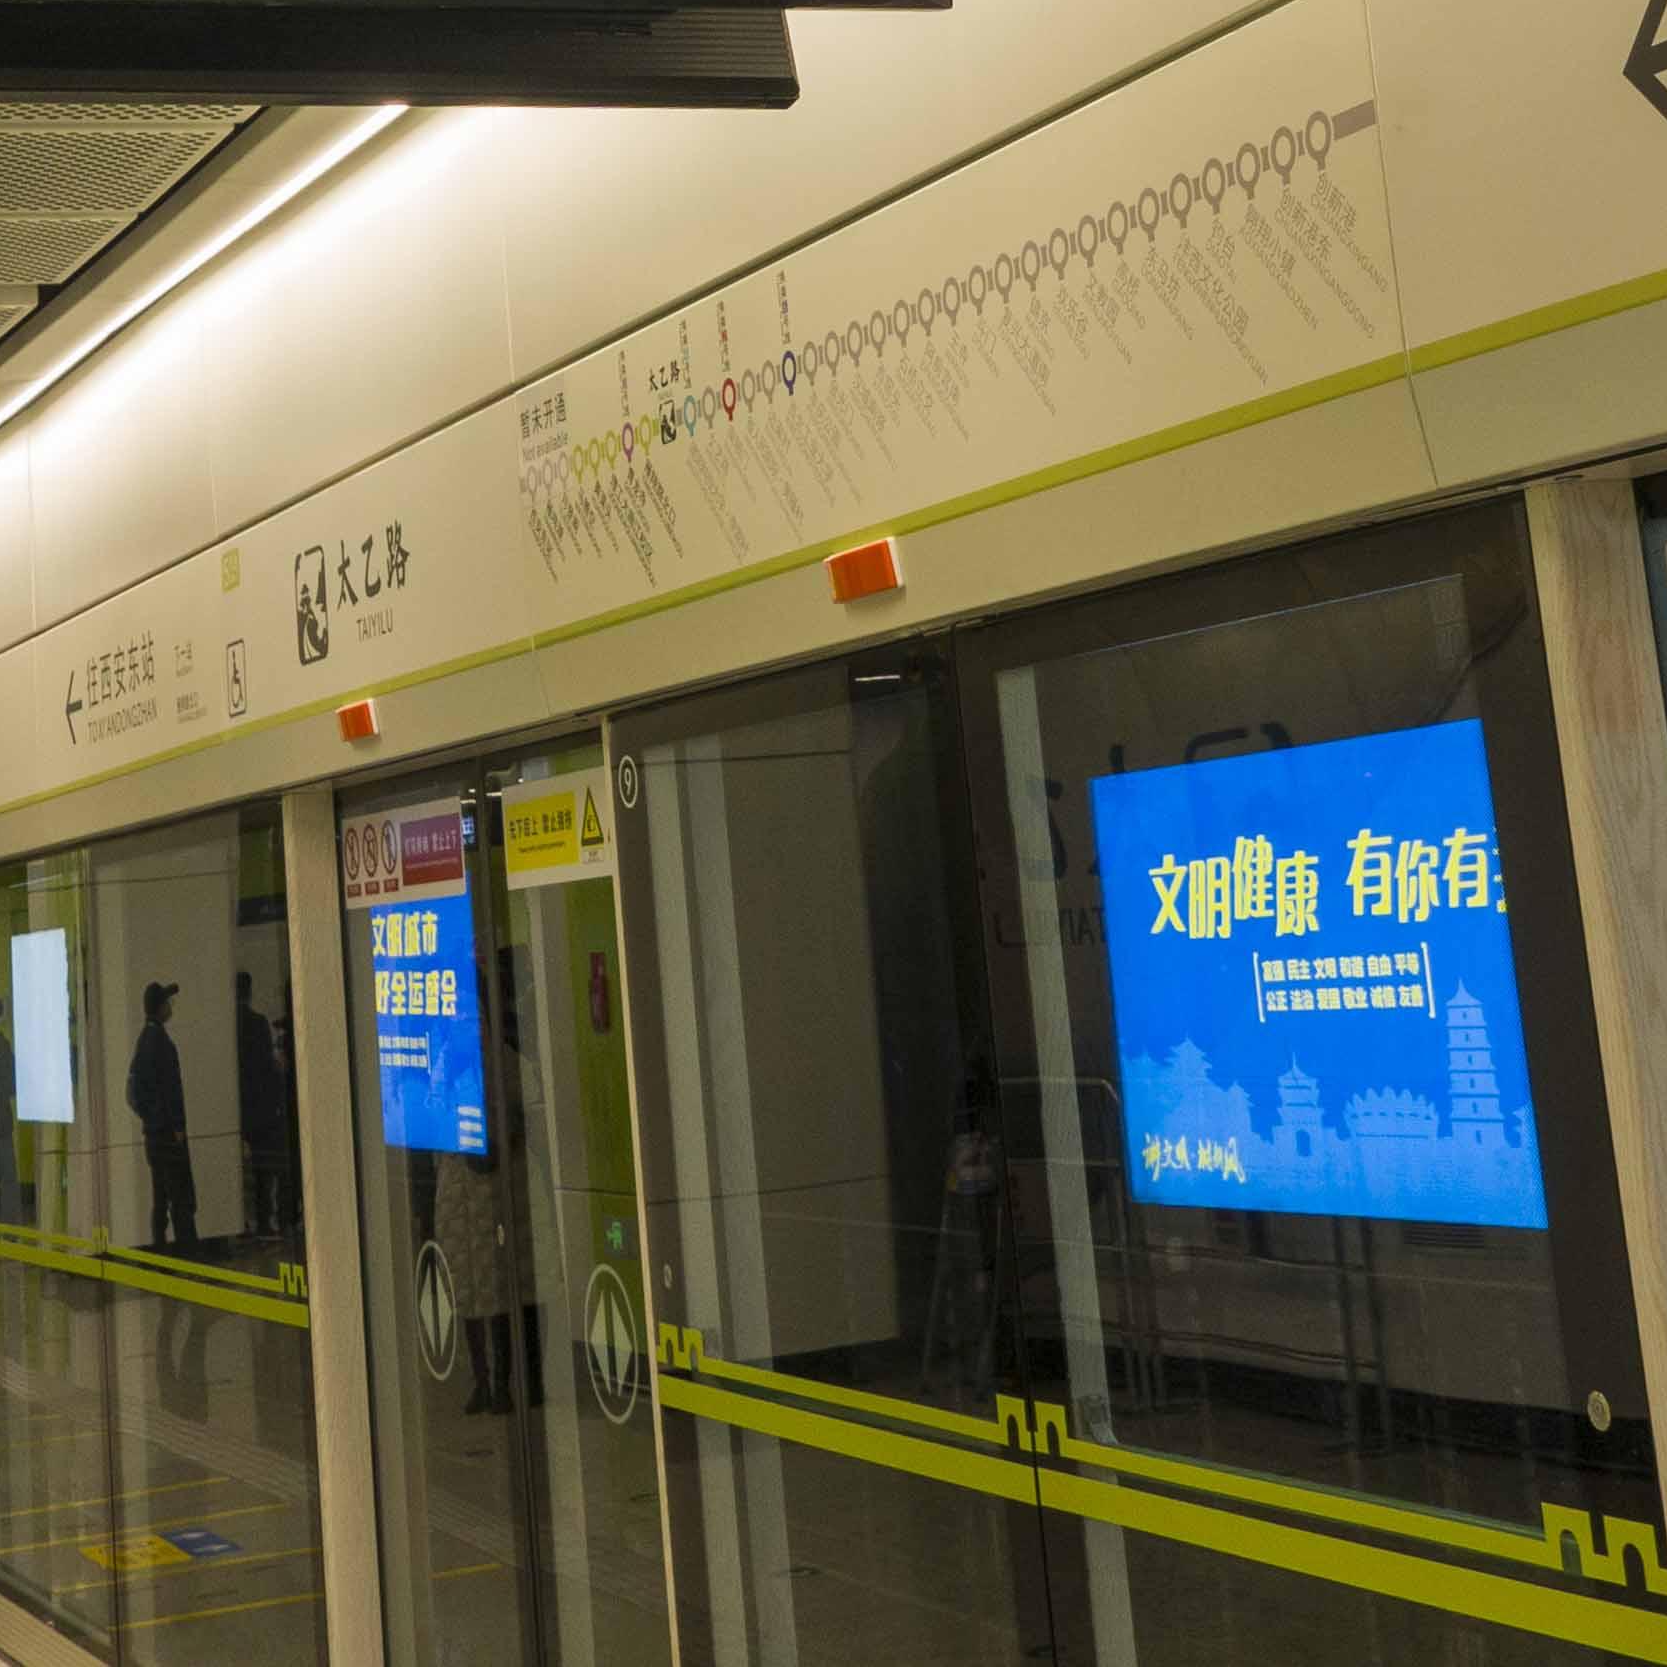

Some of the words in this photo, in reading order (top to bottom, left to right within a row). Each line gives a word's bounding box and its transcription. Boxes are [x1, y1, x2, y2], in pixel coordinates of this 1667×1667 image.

[337, 520, 410, 612] 太乙路
[356, 610, 394, 643] TAIYILU
[86, 632, 156, 708] 往西安东站
[1149, 834, 1319, 939] 文明健康
[1346, 827, 1508, 923] 有你有
